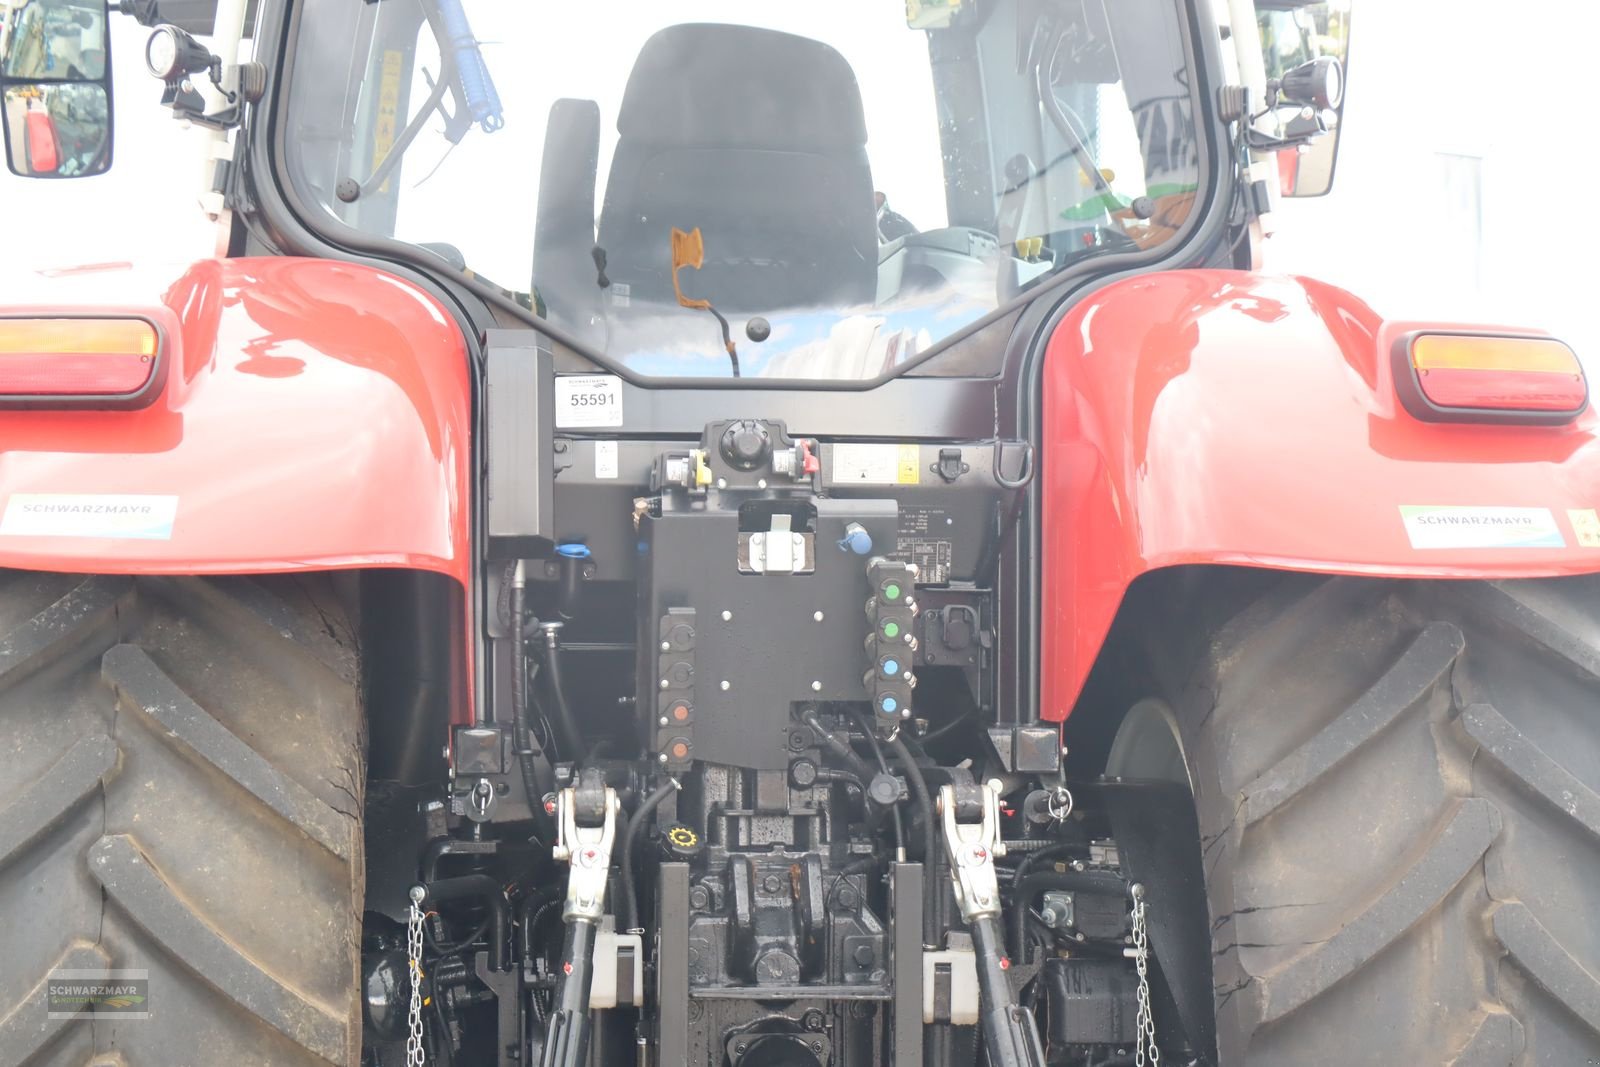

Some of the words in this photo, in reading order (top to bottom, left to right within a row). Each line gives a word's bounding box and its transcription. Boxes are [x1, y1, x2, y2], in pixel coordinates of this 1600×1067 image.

[571, 393, 614, 406] 55591
[23, 504, 152, 514] SCHWARZMAYR
[1417, 516, 1532, 525] SCHWARZMAYR
